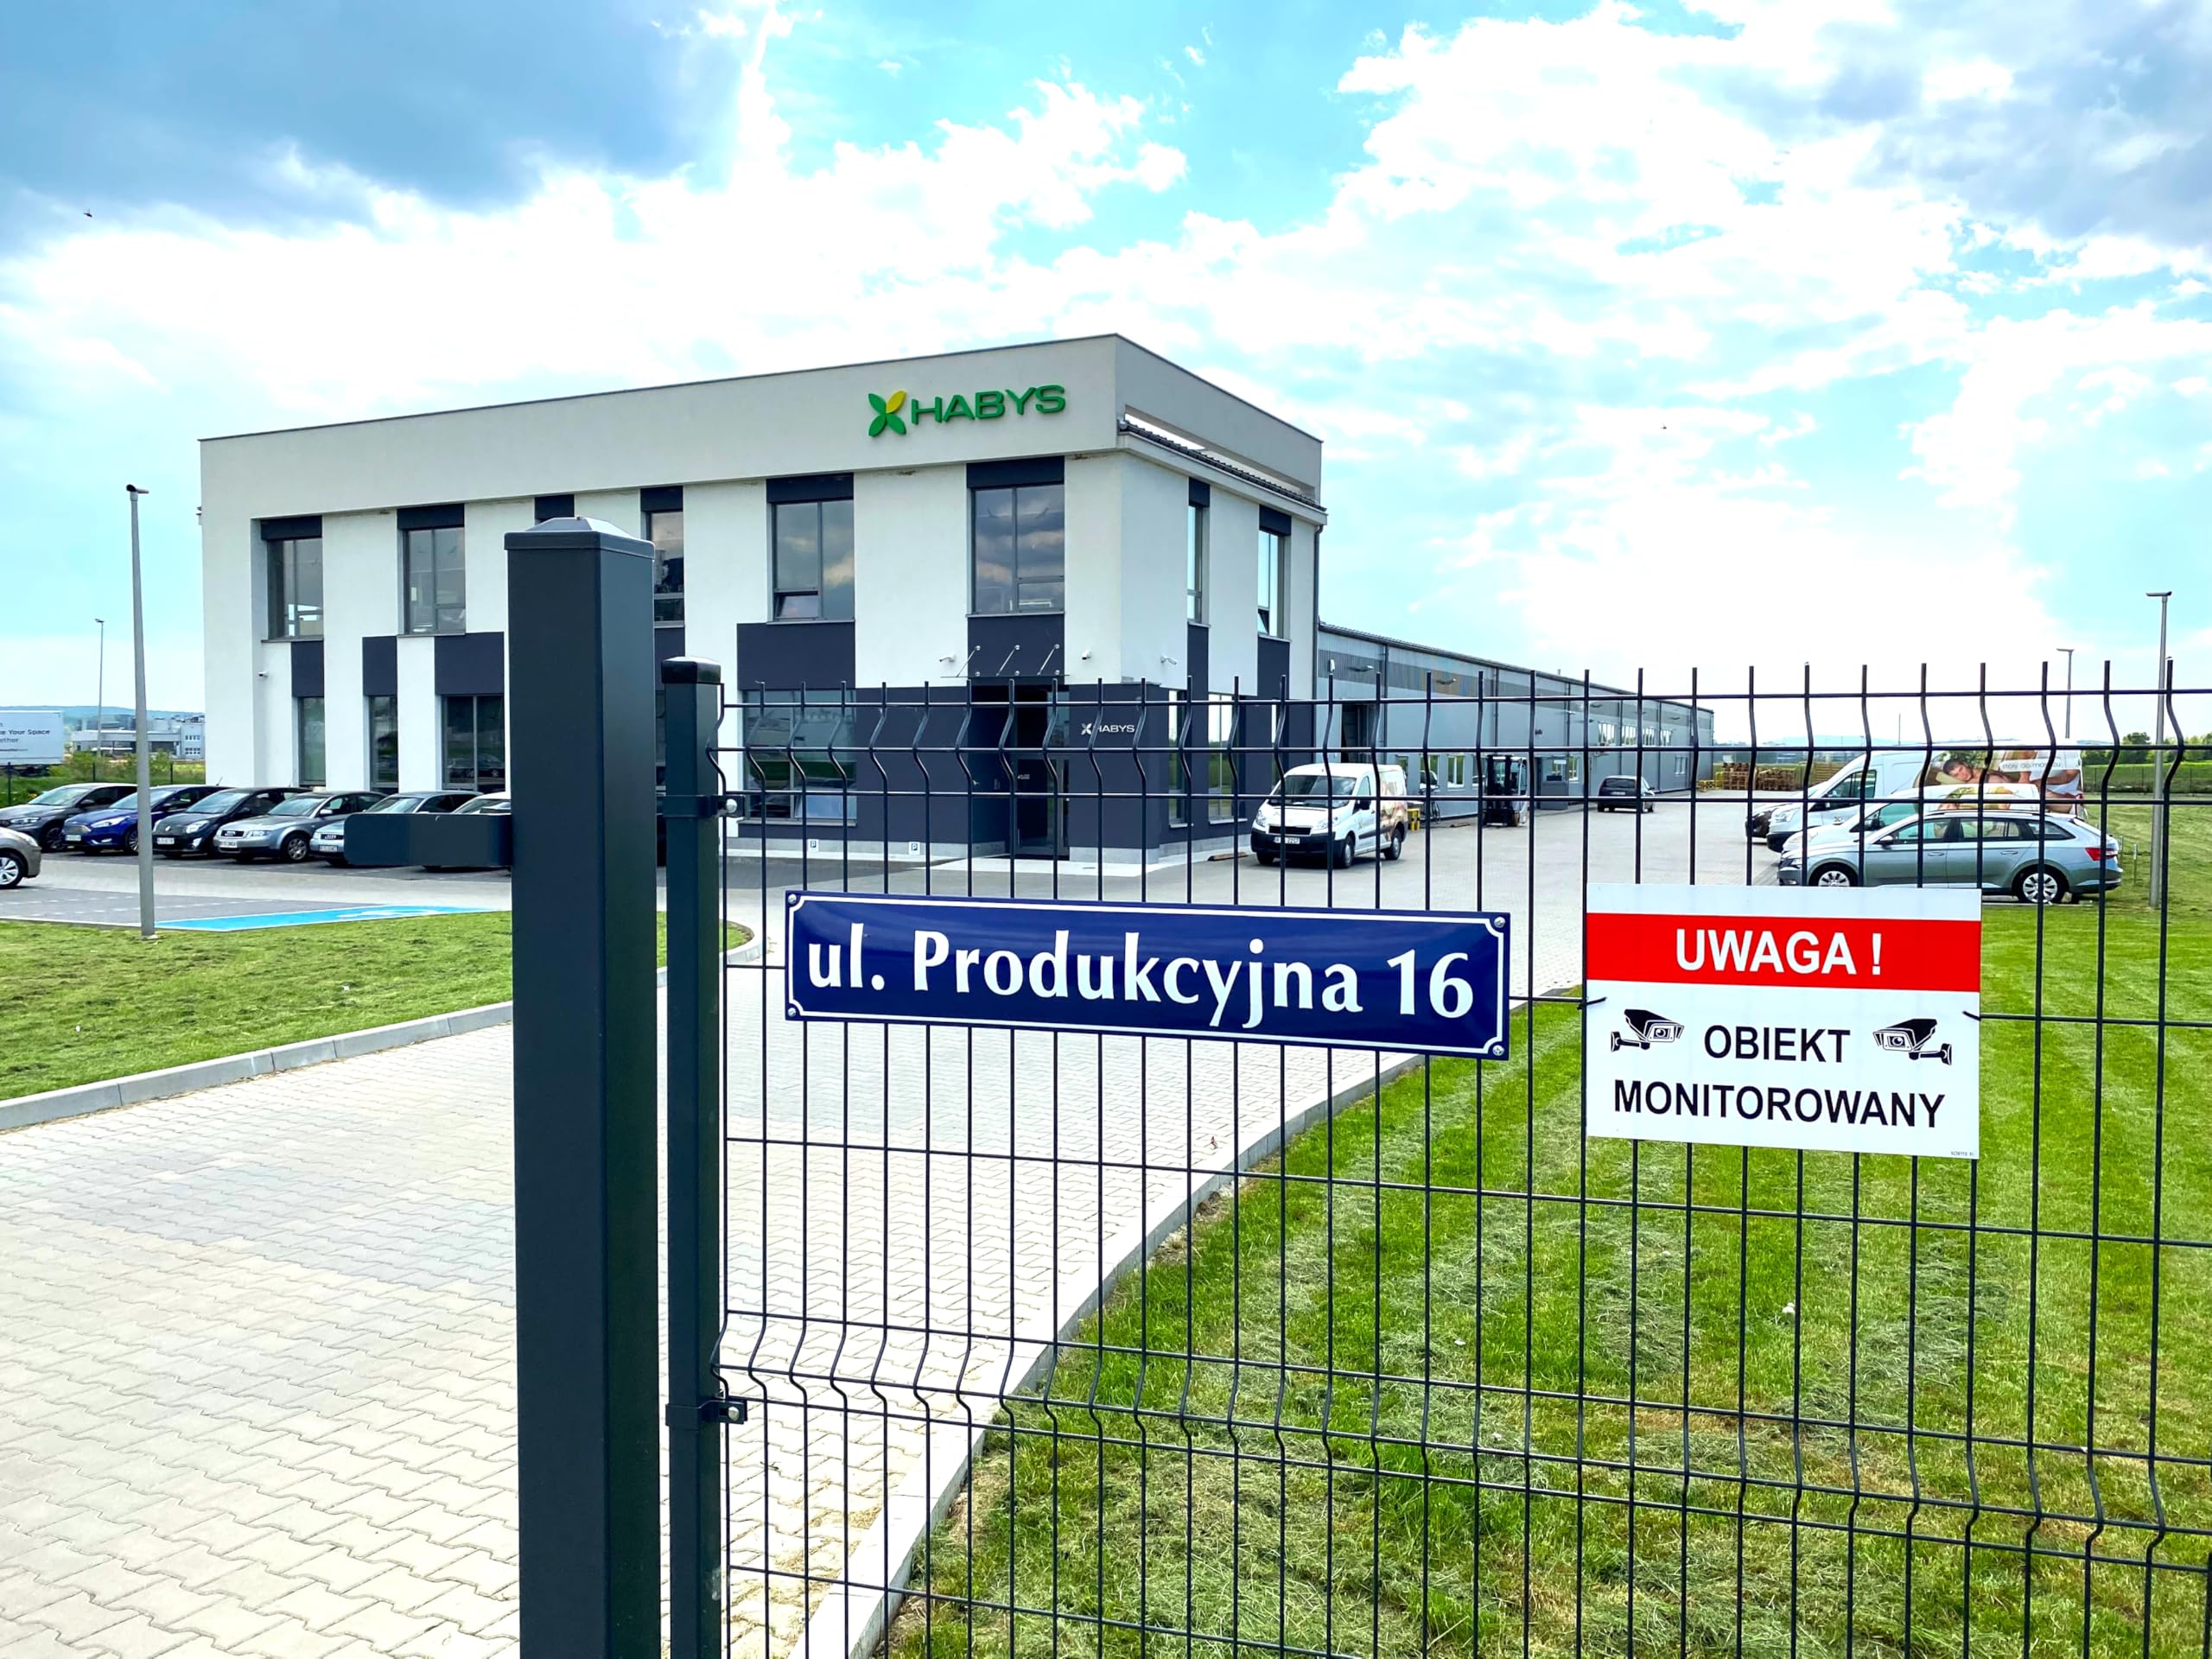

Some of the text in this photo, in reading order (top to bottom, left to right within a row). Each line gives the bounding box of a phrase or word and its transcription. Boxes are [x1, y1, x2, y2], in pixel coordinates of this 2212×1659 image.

[912, 385, 1066, 425] HABYS
[1676, 928, 1857, 975] UWAGA
[808, 923, 1473, 1029] ul. Produkcyjna 16
[1704, 1025, 1851, 1063] OBIEKT
[1615, 1079, 1945, 1128] MONITOROWANY
